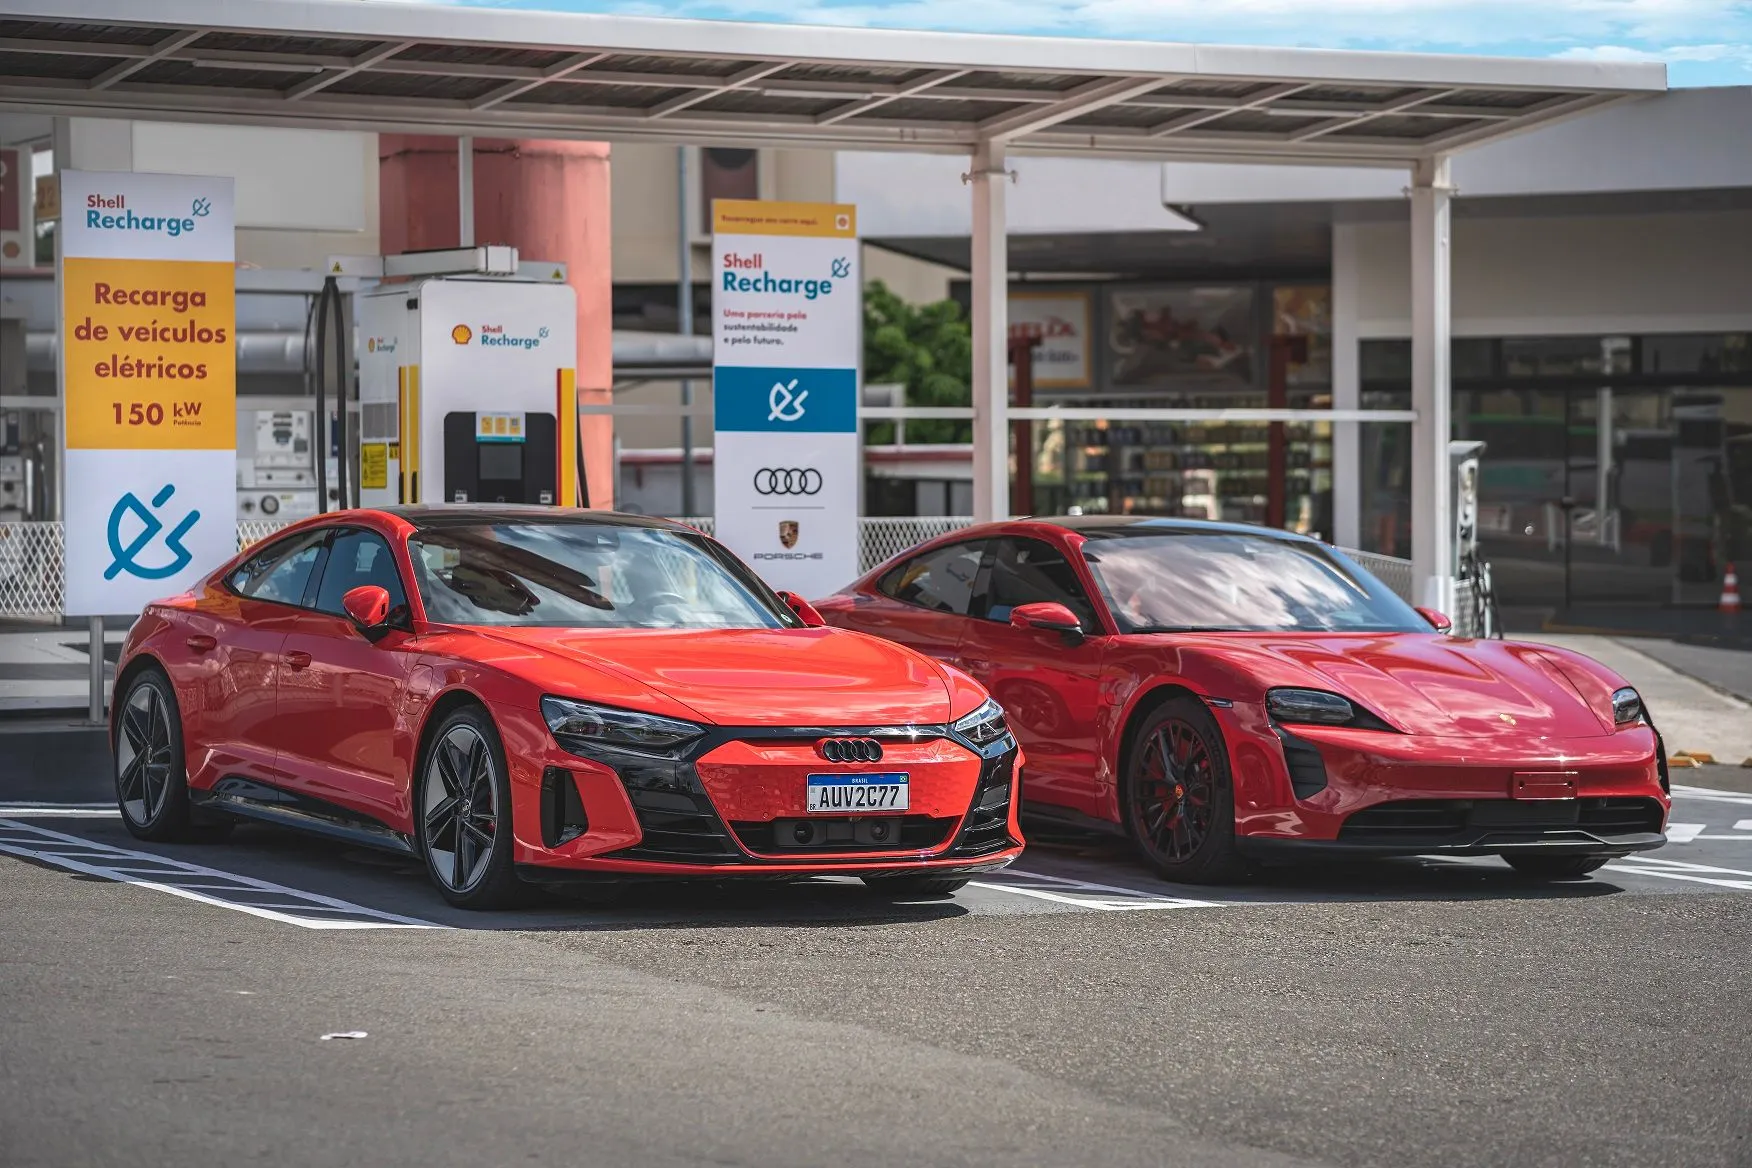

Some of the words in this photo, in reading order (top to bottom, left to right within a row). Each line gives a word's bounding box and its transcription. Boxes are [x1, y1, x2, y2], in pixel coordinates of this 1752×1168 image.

[87, 194, 125, 209] Shell
[86, 209, 195, 237] Recharge
[723, 253, 763, 269] Shell
[722, 270, 832, 299] Recharge
[95, 282, 206, 313] Recarga
[74, 316, 109, 341] de
[117, 319, 227, 344] veículos
[481, 325, 503, 333] Shell
[481, 334, 540, 349] Recharge
[94, 354, 208, 379] elétricos
[112, 402, 164, 426] 150
[173, 402, 202, 417] kW
[753, 552, 824, 560] PORSCHE
[819, 785, 900, 808] AUV2C77
